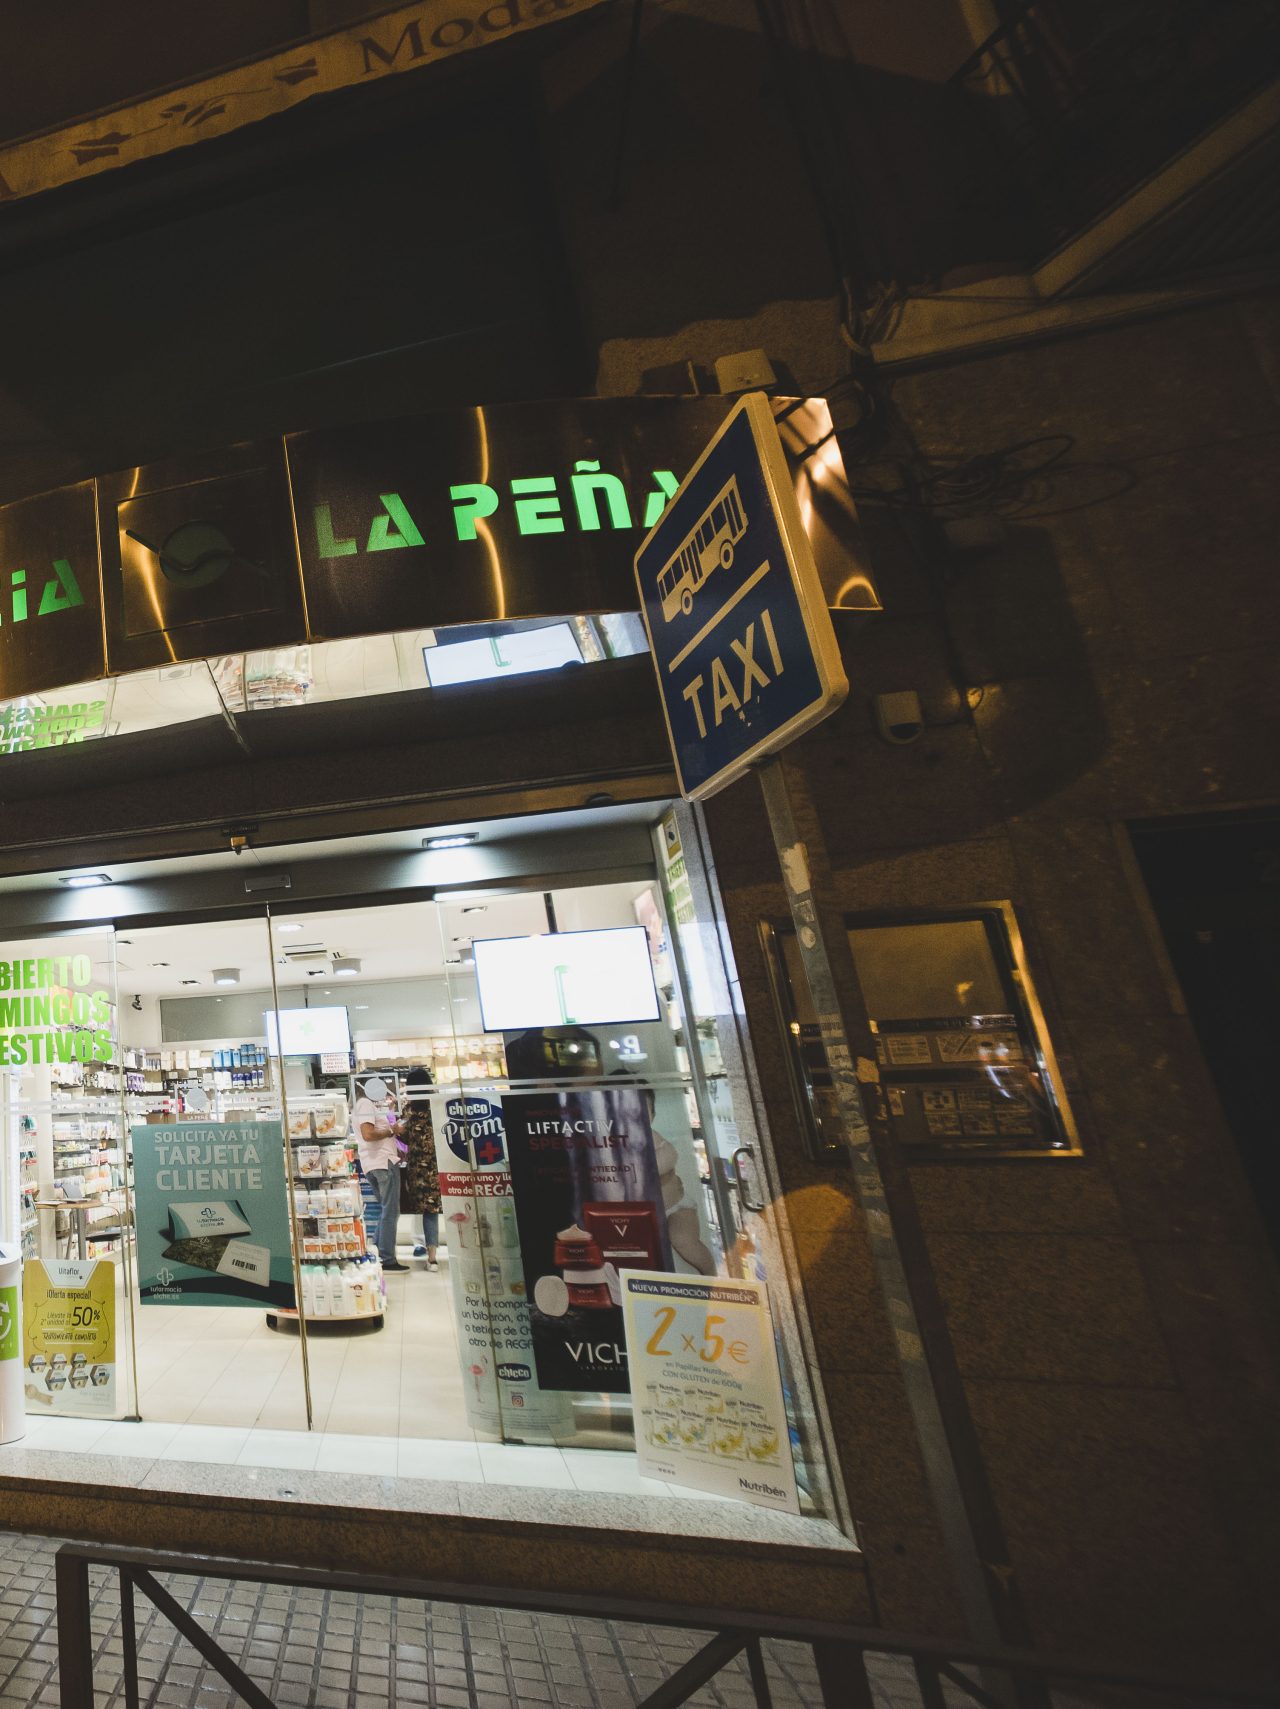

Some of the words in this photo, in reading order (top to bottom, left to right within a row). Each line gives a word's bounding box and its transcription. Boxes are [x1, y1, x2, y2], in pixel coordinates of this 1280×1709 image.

[315, 492, 426, 558] LA
[682, 608, 784, 740] TAXI
[527, 1120, 613, 1135] LIFTACTIV
[154, 1130, 214, 1143] SOLICITA
[219, 1129, 237, 1142] YA
[240, 1129, 259, 1141] TU
[154, 1144, 261, 1165] TARJETA
[156, 1168, 263, 1191] CLIENTE
[632, 1283, 658, 1293] NUEVA
[660, 1286, 709, 1298] PROMOCIÓN
[465, 1296, 479, 1306] Por
[504, 1326, 517, 1335] de
[469, 1338, 487, 1347] otro
[563, 1341, 627, 1364] VICH
[499, 1366, 529, 1378] chicco
[663, 1370, 679, 1379] CON
[680, 1373, 710, 1384] GLUTEN
[739, 1478, 787, 1498] Nutribén
